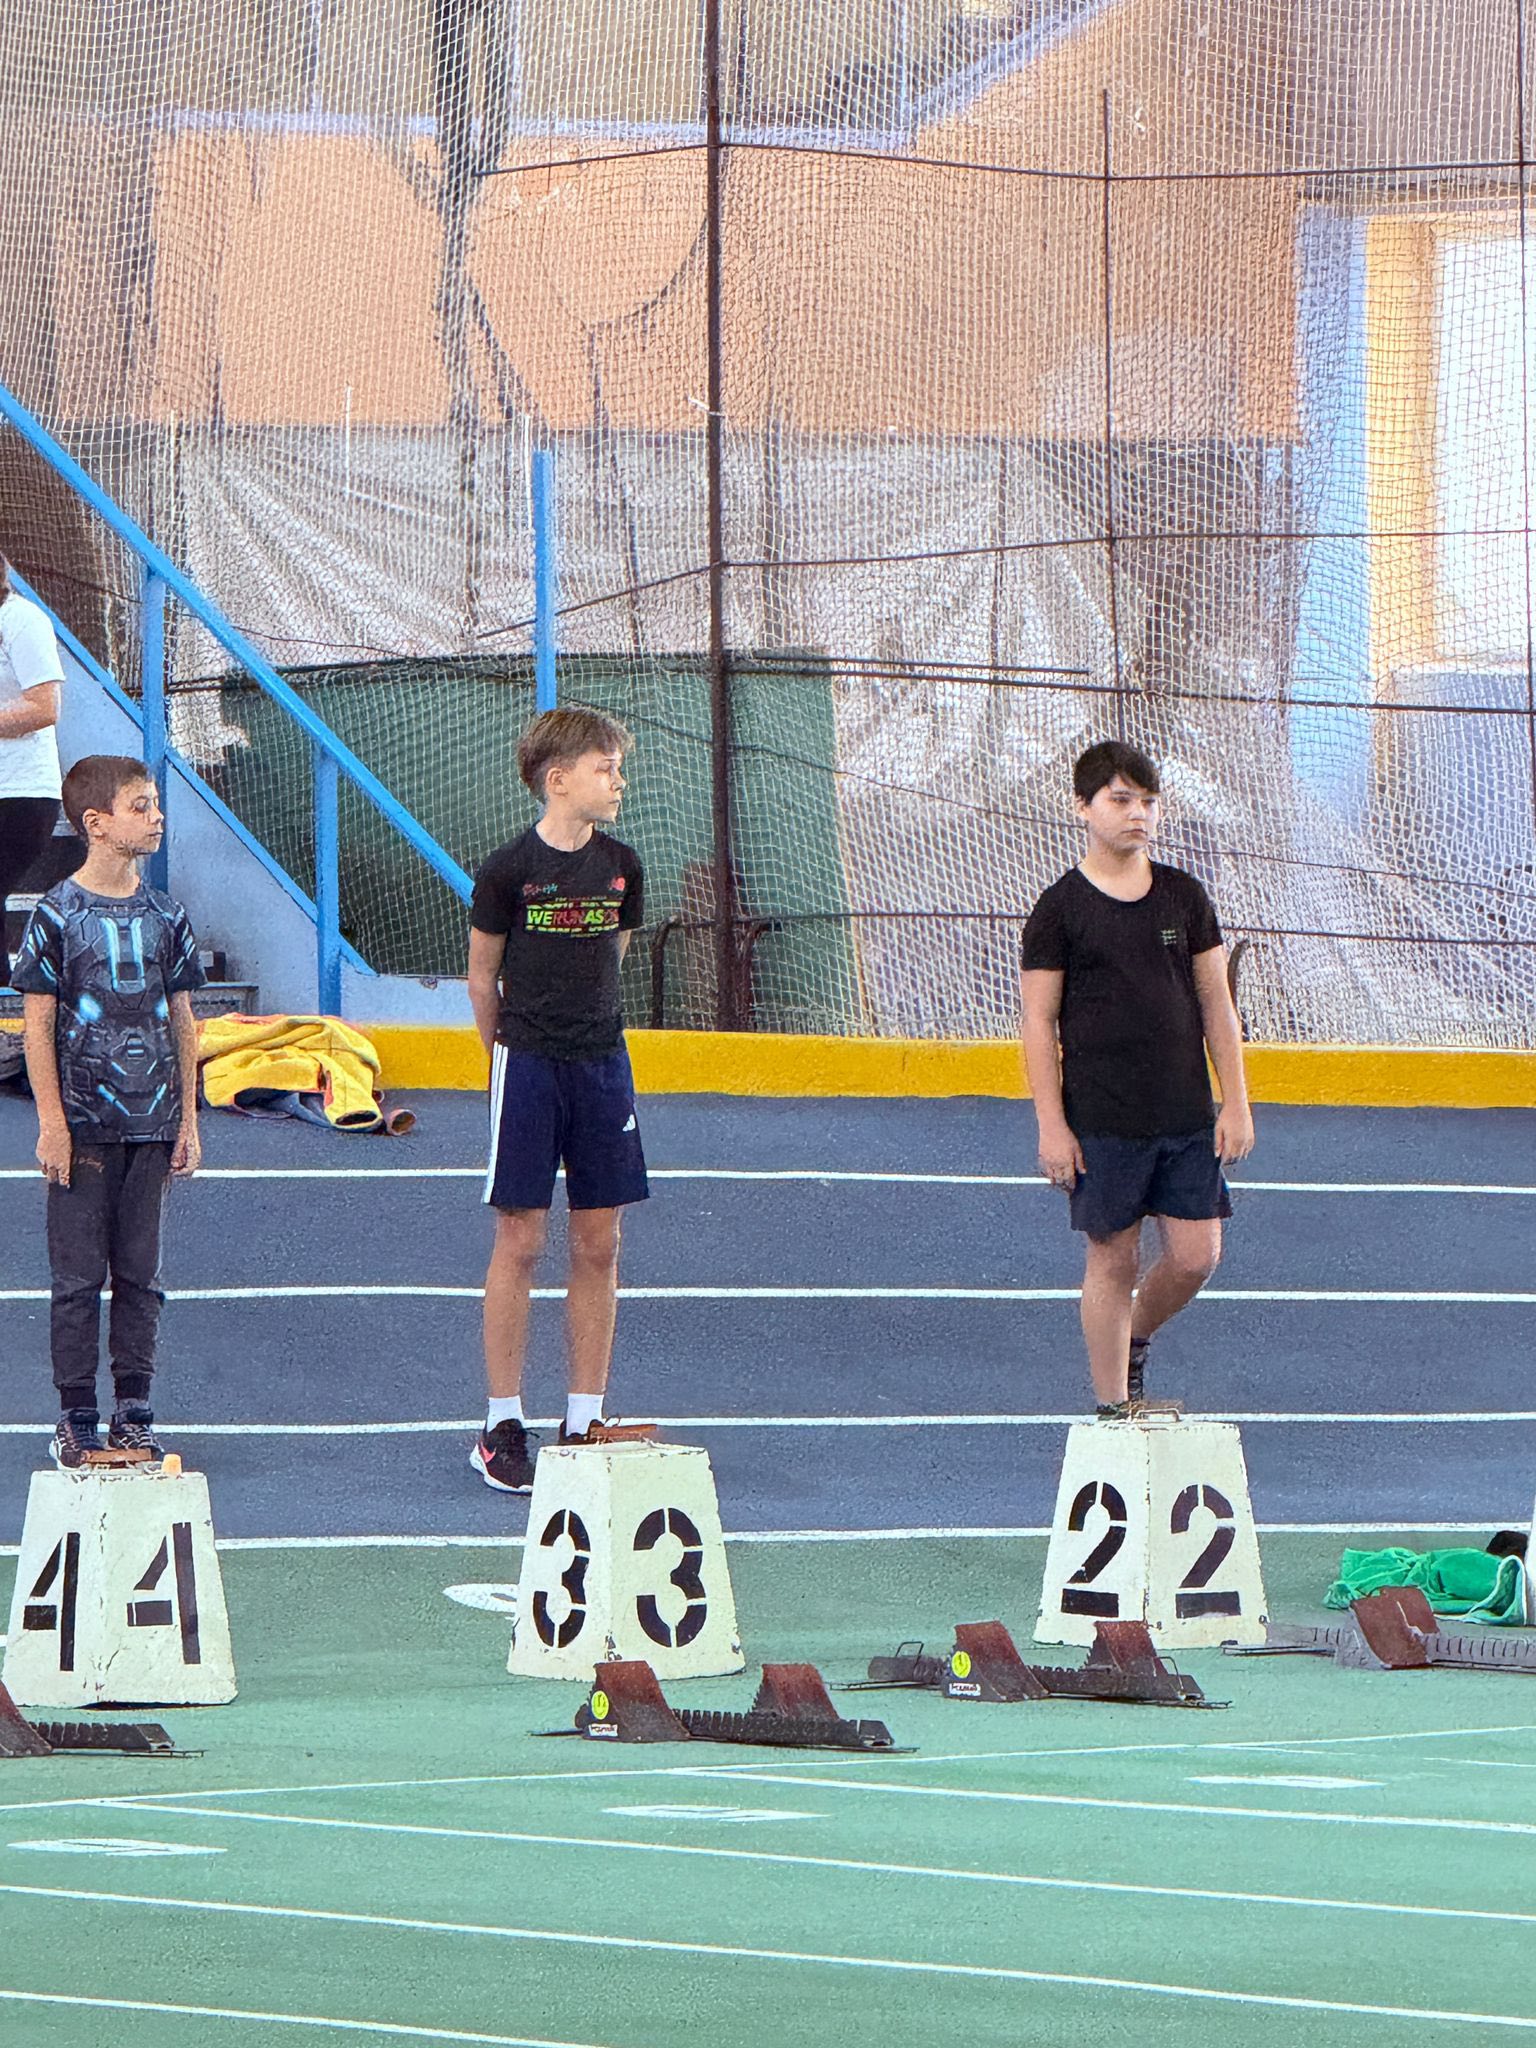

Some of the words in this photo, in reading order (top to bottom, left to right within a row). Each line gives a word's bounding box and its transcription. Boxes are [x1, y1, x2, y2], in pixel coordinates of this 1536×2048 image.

[22, 1532, 81, 1672] 4
[126, 1522, 201, 1665] 4
[532, 1508, 591, 1648] 3
[633, 1507, 708, 1648] 3
[1061, 1481, 1127, 1618] 2
[1170, 1484, 1241, 1618] 2
